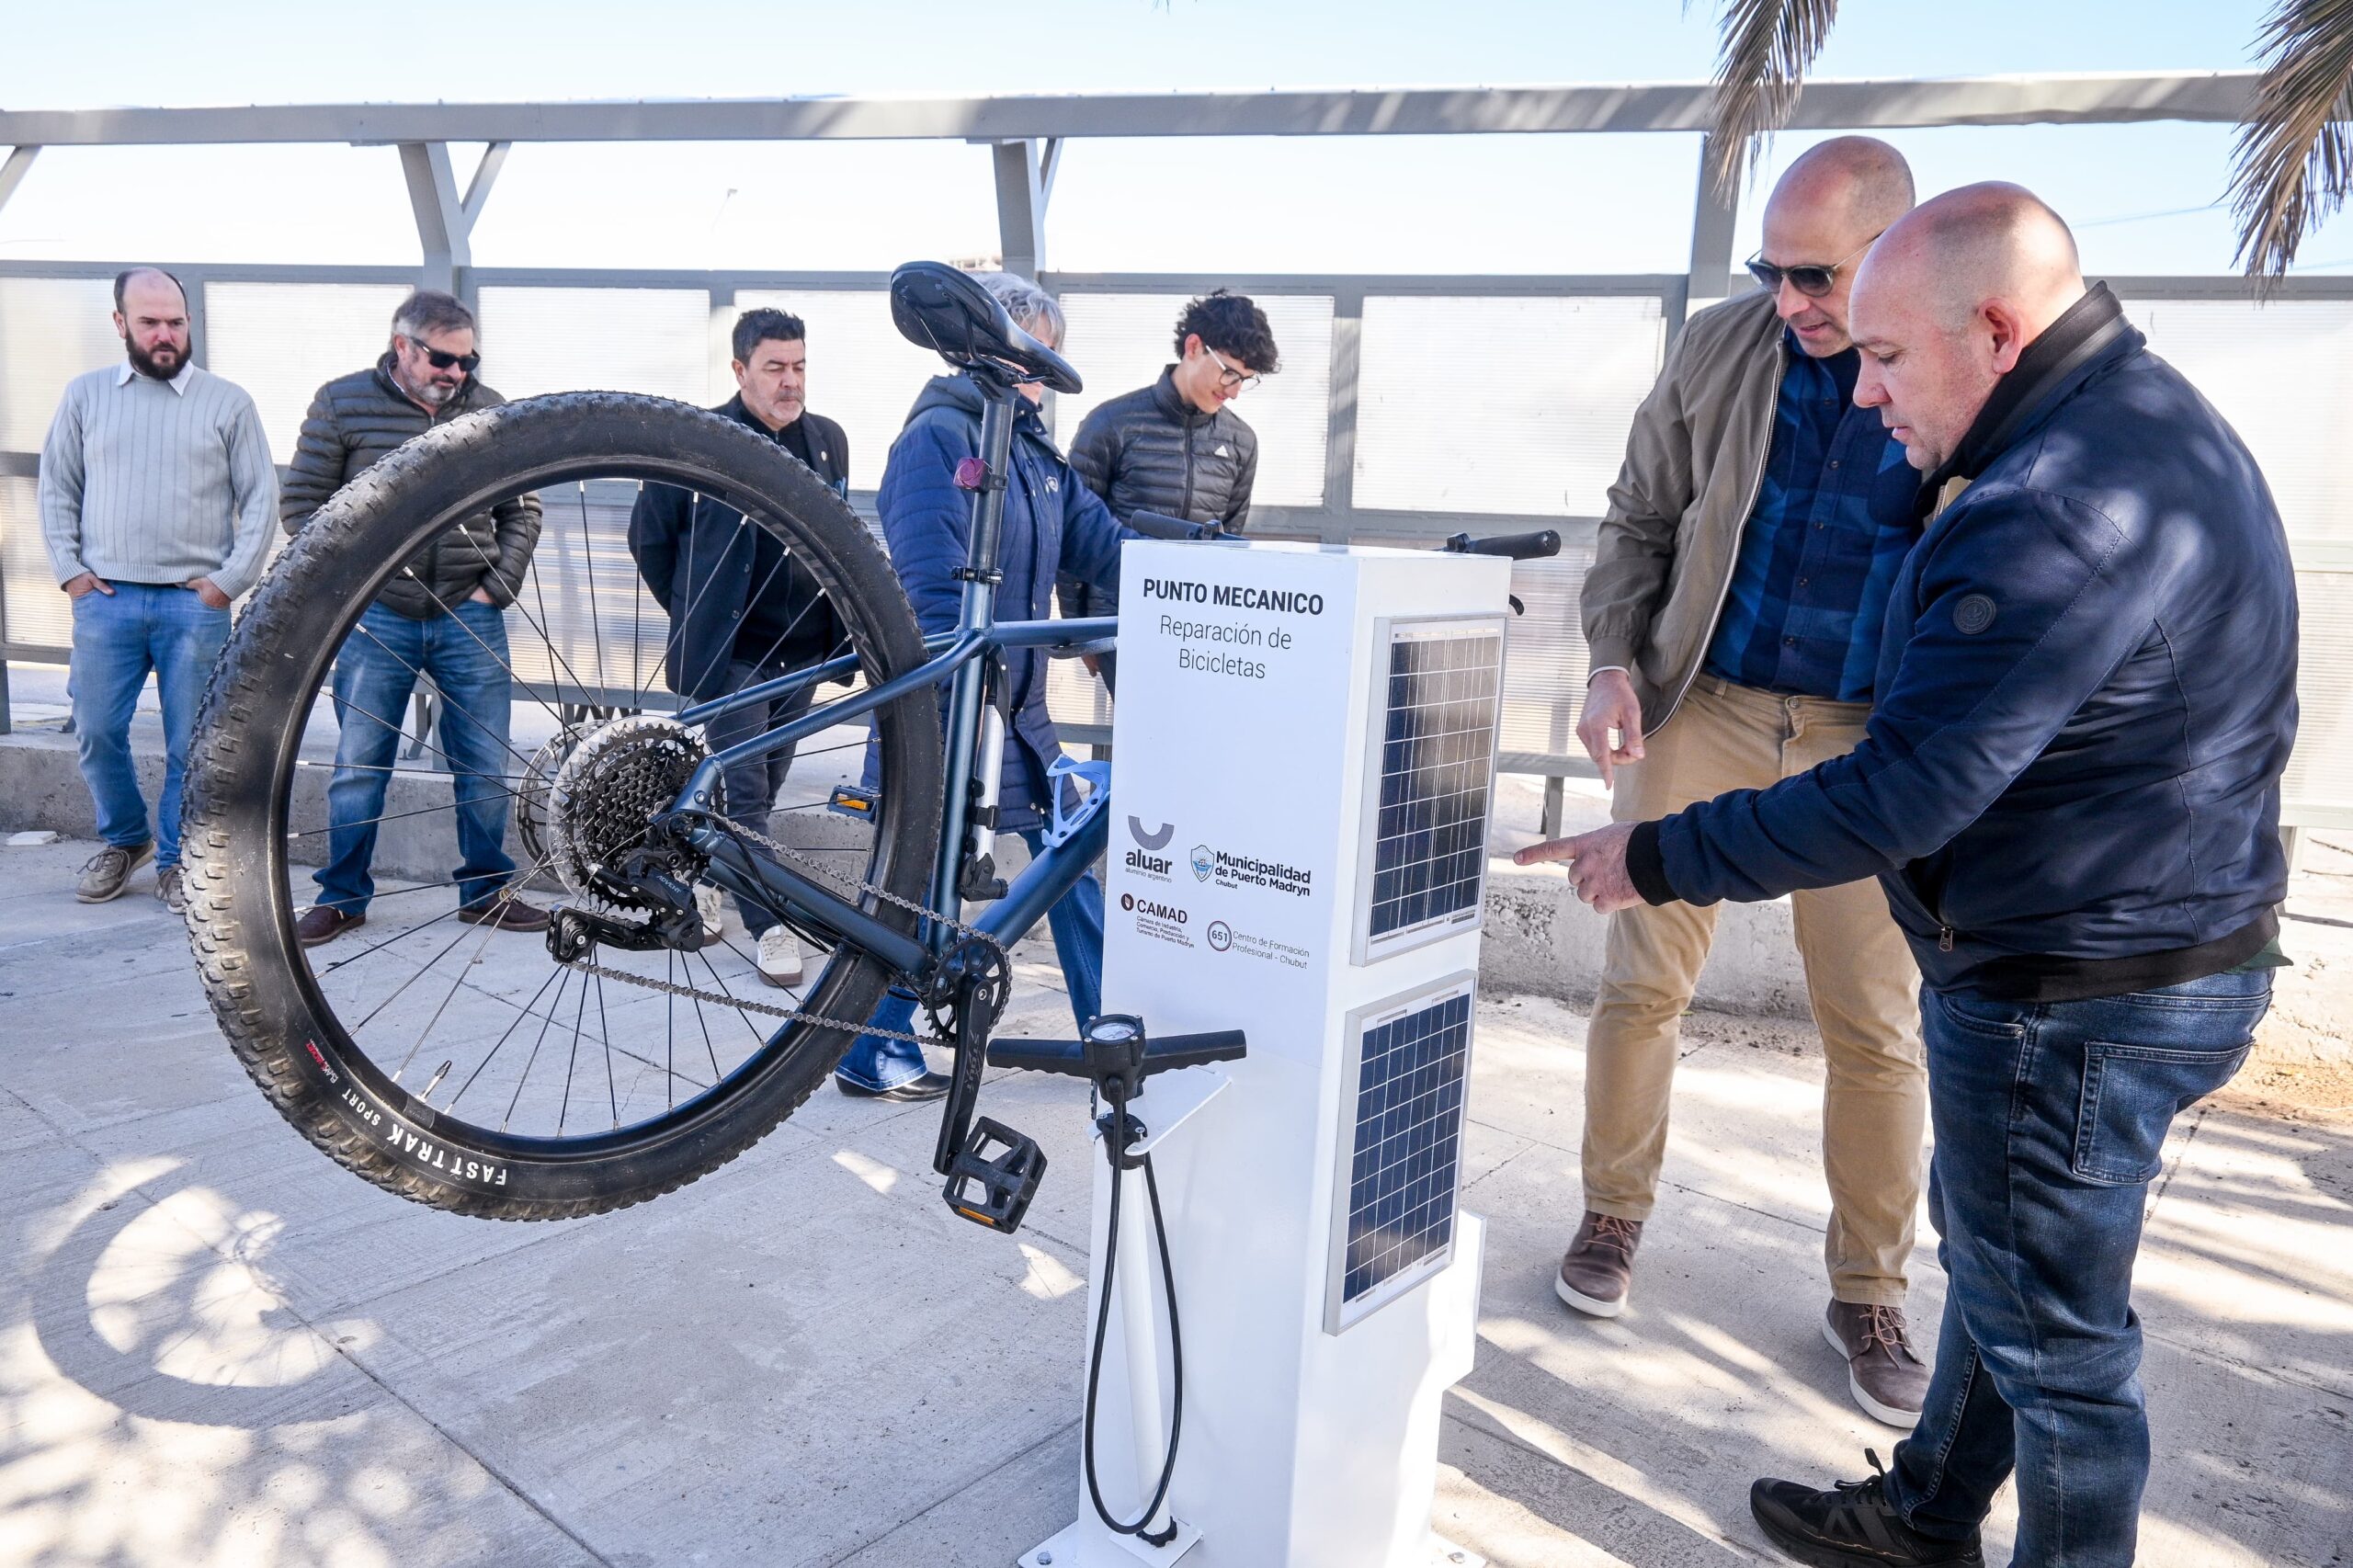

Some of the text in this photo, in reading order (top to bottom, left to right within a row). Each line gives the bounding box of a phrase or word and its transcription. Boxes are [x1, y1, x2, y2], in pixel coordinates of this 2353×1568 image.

[1142, 578, 1324, 615] PUNTO MECANICO
[1160, 615, 1292, 650] Reparación de
[1179, 648, 1266, 679] Bicicletas
[1126, 849, 1173, 875] aluar
[1216, 850, 1312, 884] Municipalidad
[1215, 866, 1311, 896] de Puerto Madryn
[1215, 879, 1238, 890] Chubut
[1137, 899, 1188, 925] CAMAD
[1211, 929, 1228, 942] 651
[1233, 930, 1310, 958] Centro de Formación
[1232, 942, 1273, 960] Profesional
[1279, 955, 1308, 970] Chubut
[342, 1088, 381, 1126] SPORT
[386, 1123, 445, 1169] TRAK
[449, 1157, 507, 1186] FAST
